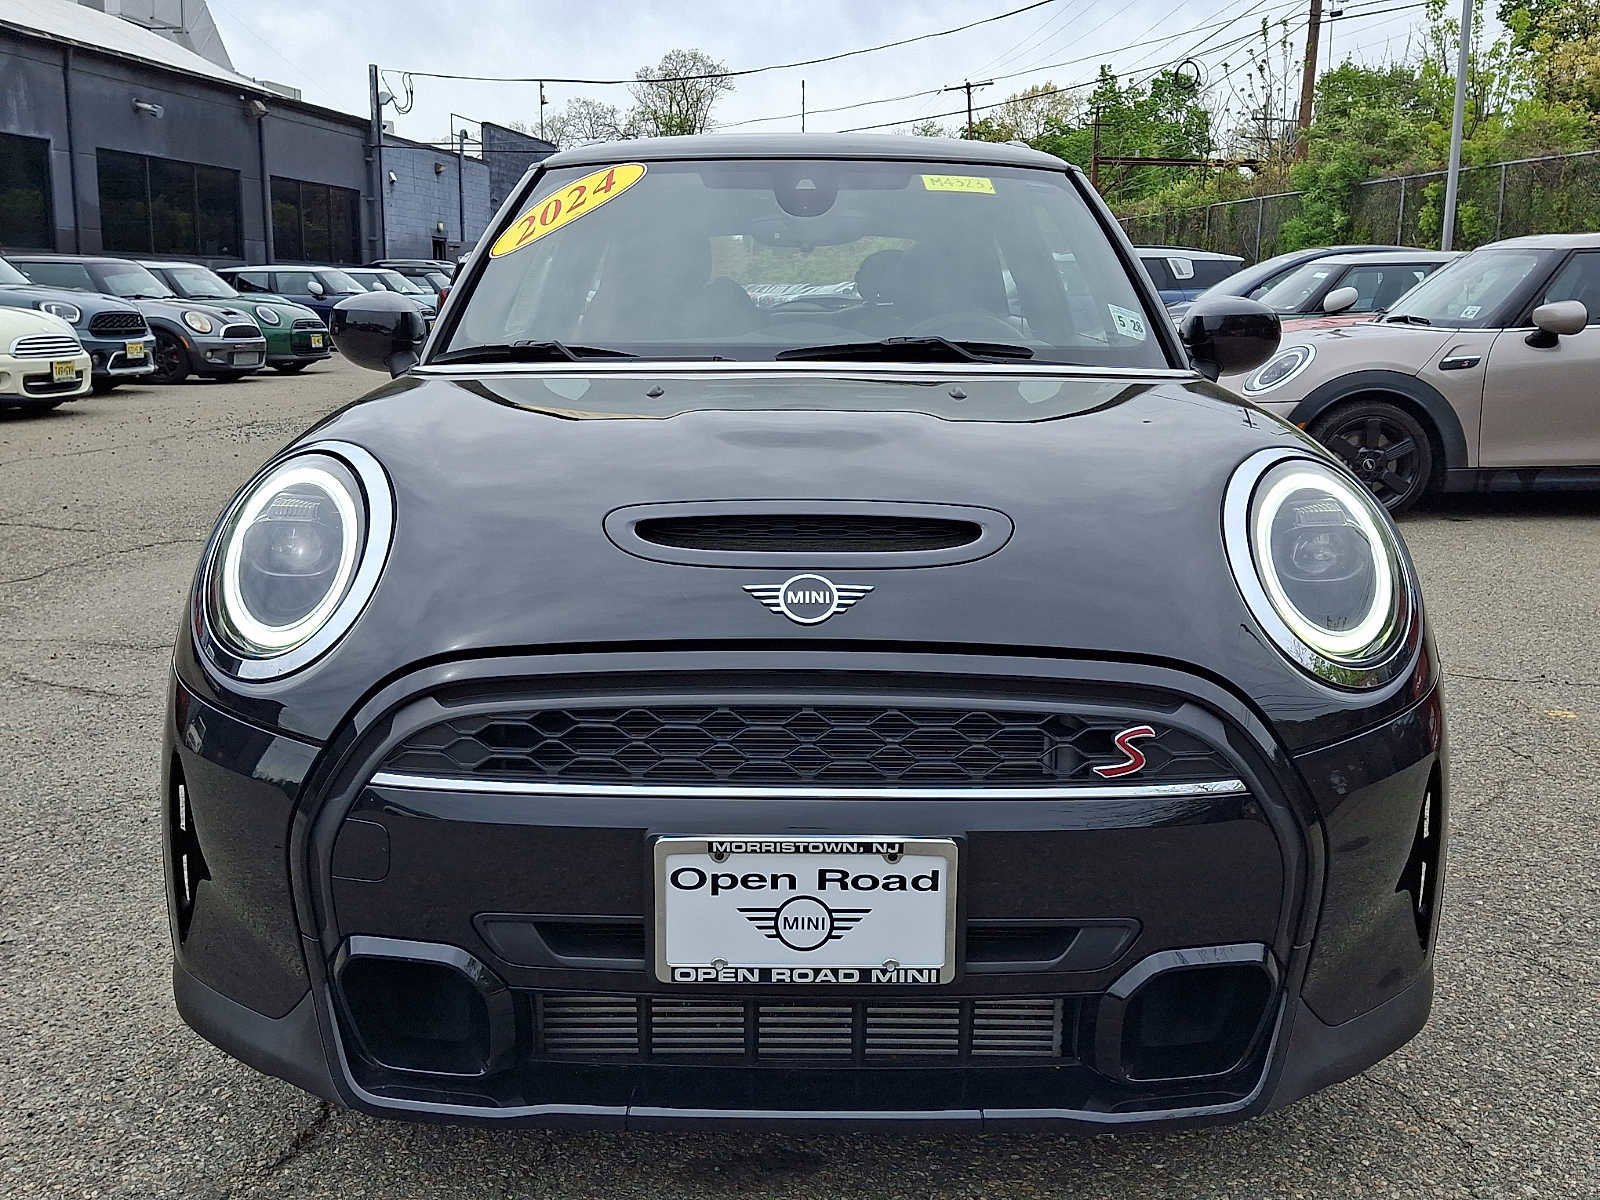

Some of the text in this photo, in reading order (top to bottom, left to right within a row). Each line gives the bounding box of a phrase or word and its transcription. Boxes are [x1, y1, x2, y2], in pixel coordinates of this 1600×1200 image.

[515, 167, 616, 246] 2024
[1117, 315, 1126, 328] 5
[787, 590, 831, 604] MINI
[1092, 725, 1156, 779] S
[711, 841, 900, 854] MORRISTOWN, NJ
[669, 866, 940, 896] Open Road
[782, 916, 826, 931] MINI
[674, 967, 938, 983] OPEN ROAD MINI
